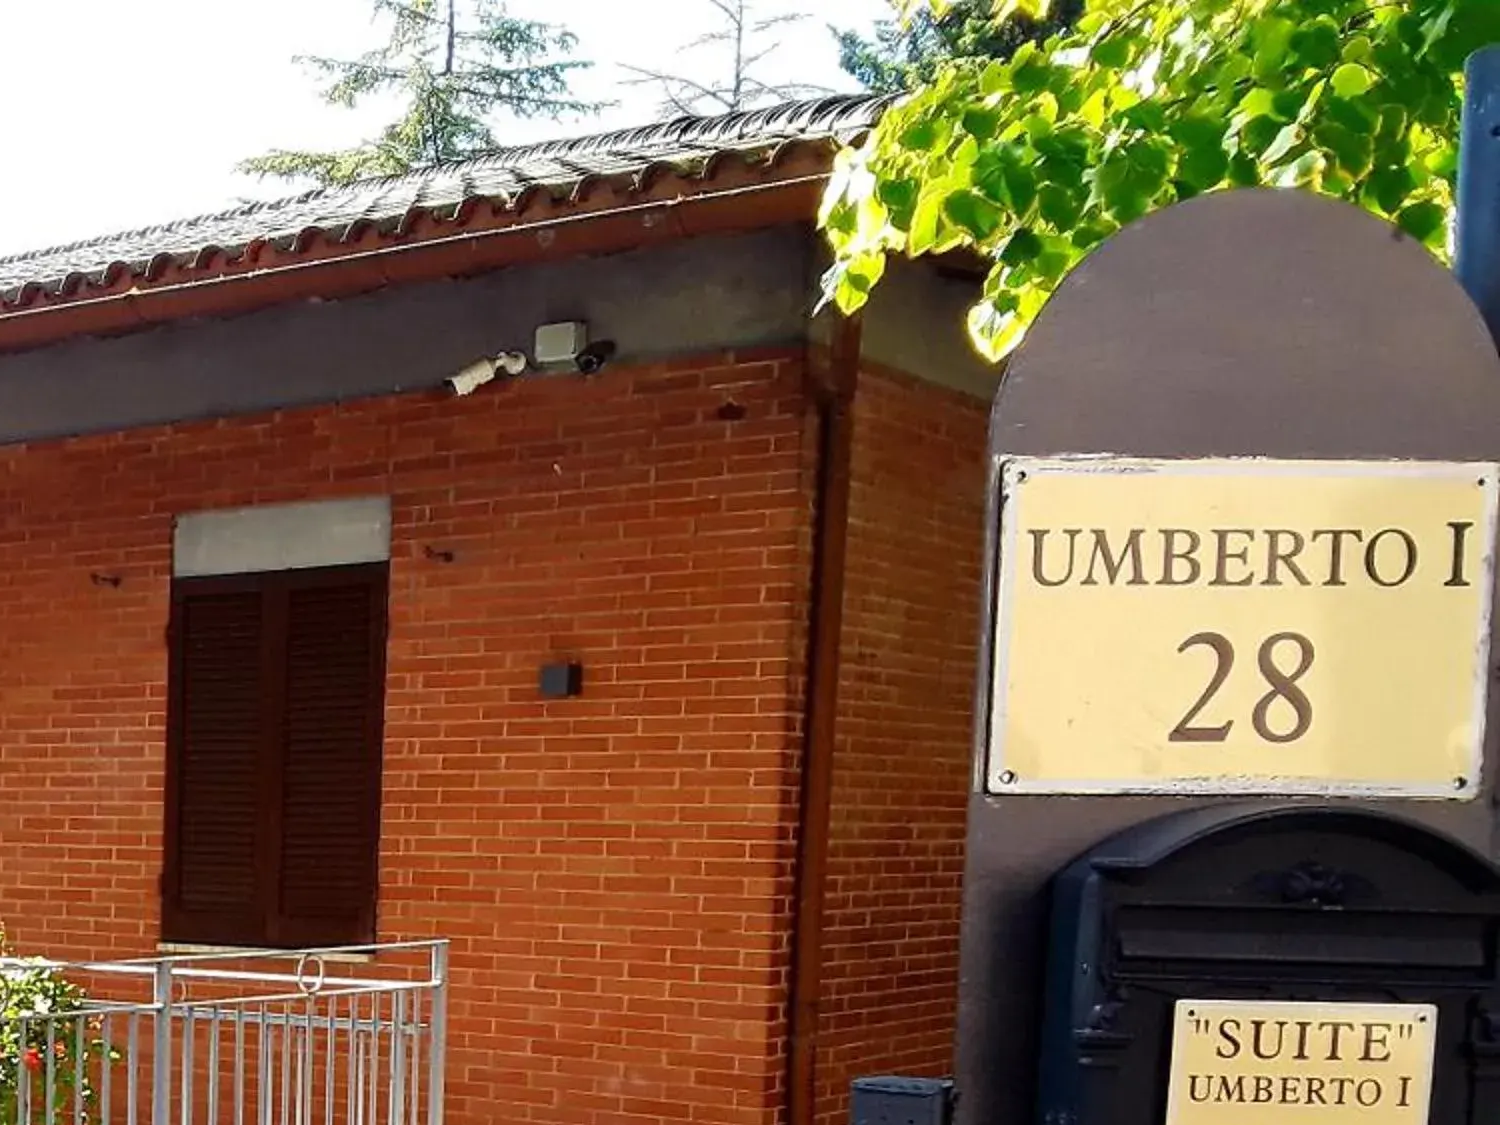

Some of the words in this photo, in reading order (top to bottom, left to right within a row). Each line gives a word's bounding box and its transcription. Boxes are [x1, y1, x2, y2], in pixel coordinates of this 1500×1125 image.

[1027, 528, 1418, 587] UMBERTO
[1443, 521, 1474, 587] I
[1167, 631, 1316, 744] 28
[1191, 1018, 1414, 1062] "SUITE"
[1187, 1074, 1382, 1107] UMBERTO
[1395, 1076, 1412, 1107] I
